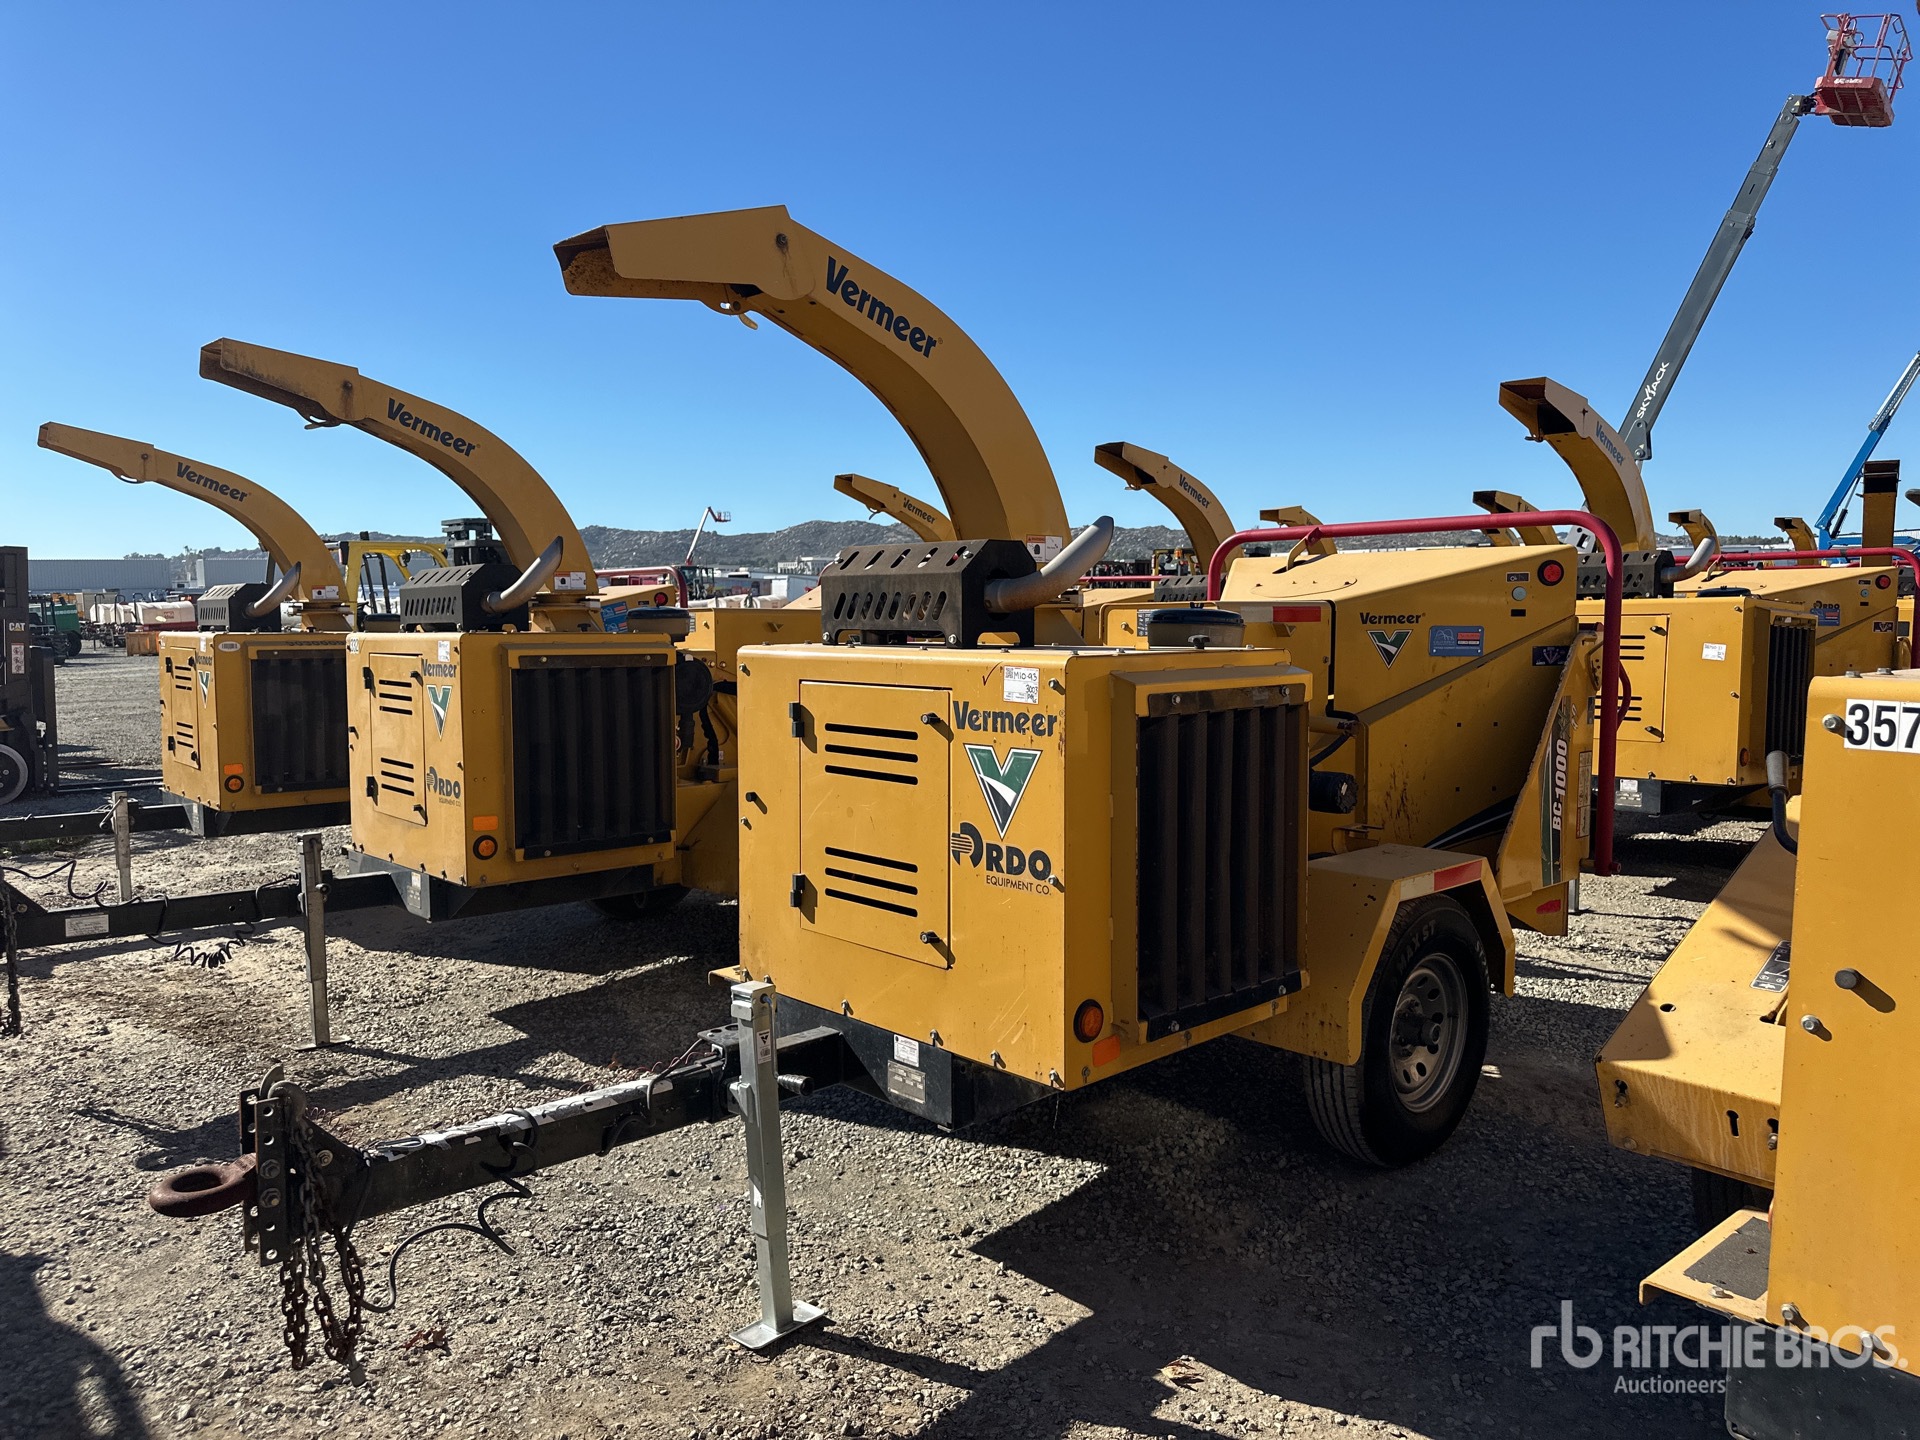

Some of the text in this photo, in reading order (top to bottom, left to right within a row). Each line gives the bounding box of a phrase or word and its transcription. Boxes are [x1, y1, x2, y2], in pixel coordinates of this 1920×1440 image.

[826, 255, 937, 358] Vermeer
[1636, 362, 1669, 419] SKYJACK
[387, 398, 476, 457] Vermeer
[1595, 421, 1624, 466] Vermeer
[176, 462, 248, 503] Vermeer
[1179, 473, 1210, 509] Vermeer
[902, 497, 936, 524] Vermeer
[9, 622, 25, 632] CAT
[1359, 612, 1421, 625] Vermeer
[421, 657, 458, 679] Vermeer
[952, 699, 1058, 738] Vermeer
[985, 874, 1034, 893] EQUIPMENT
